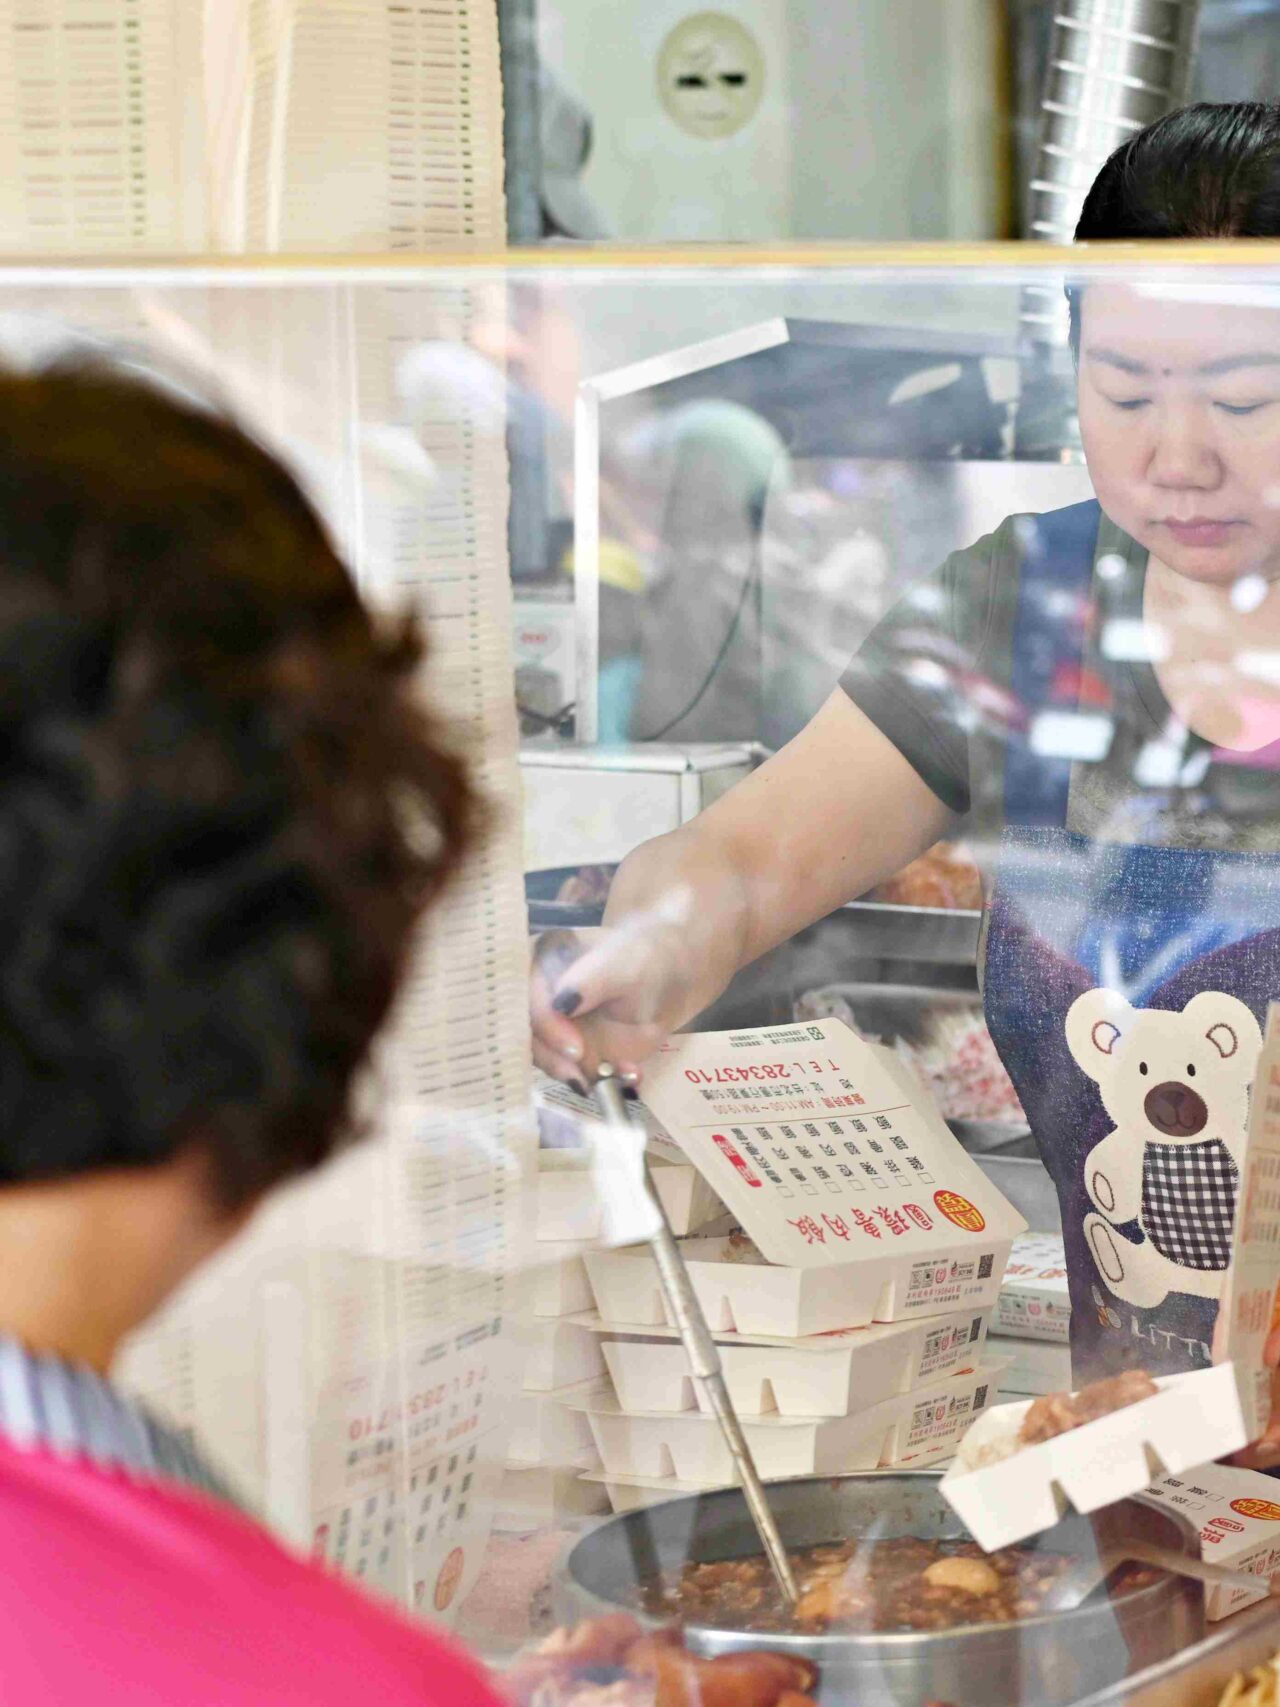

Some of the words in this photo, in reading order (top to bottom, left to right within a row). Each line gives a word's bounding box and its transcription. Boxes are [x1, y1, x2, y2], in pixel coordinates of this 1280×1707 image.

[684, 1063, 791, 1084] 28343710
[787, 1203, 933, 1244] 圓環魯肉飯
